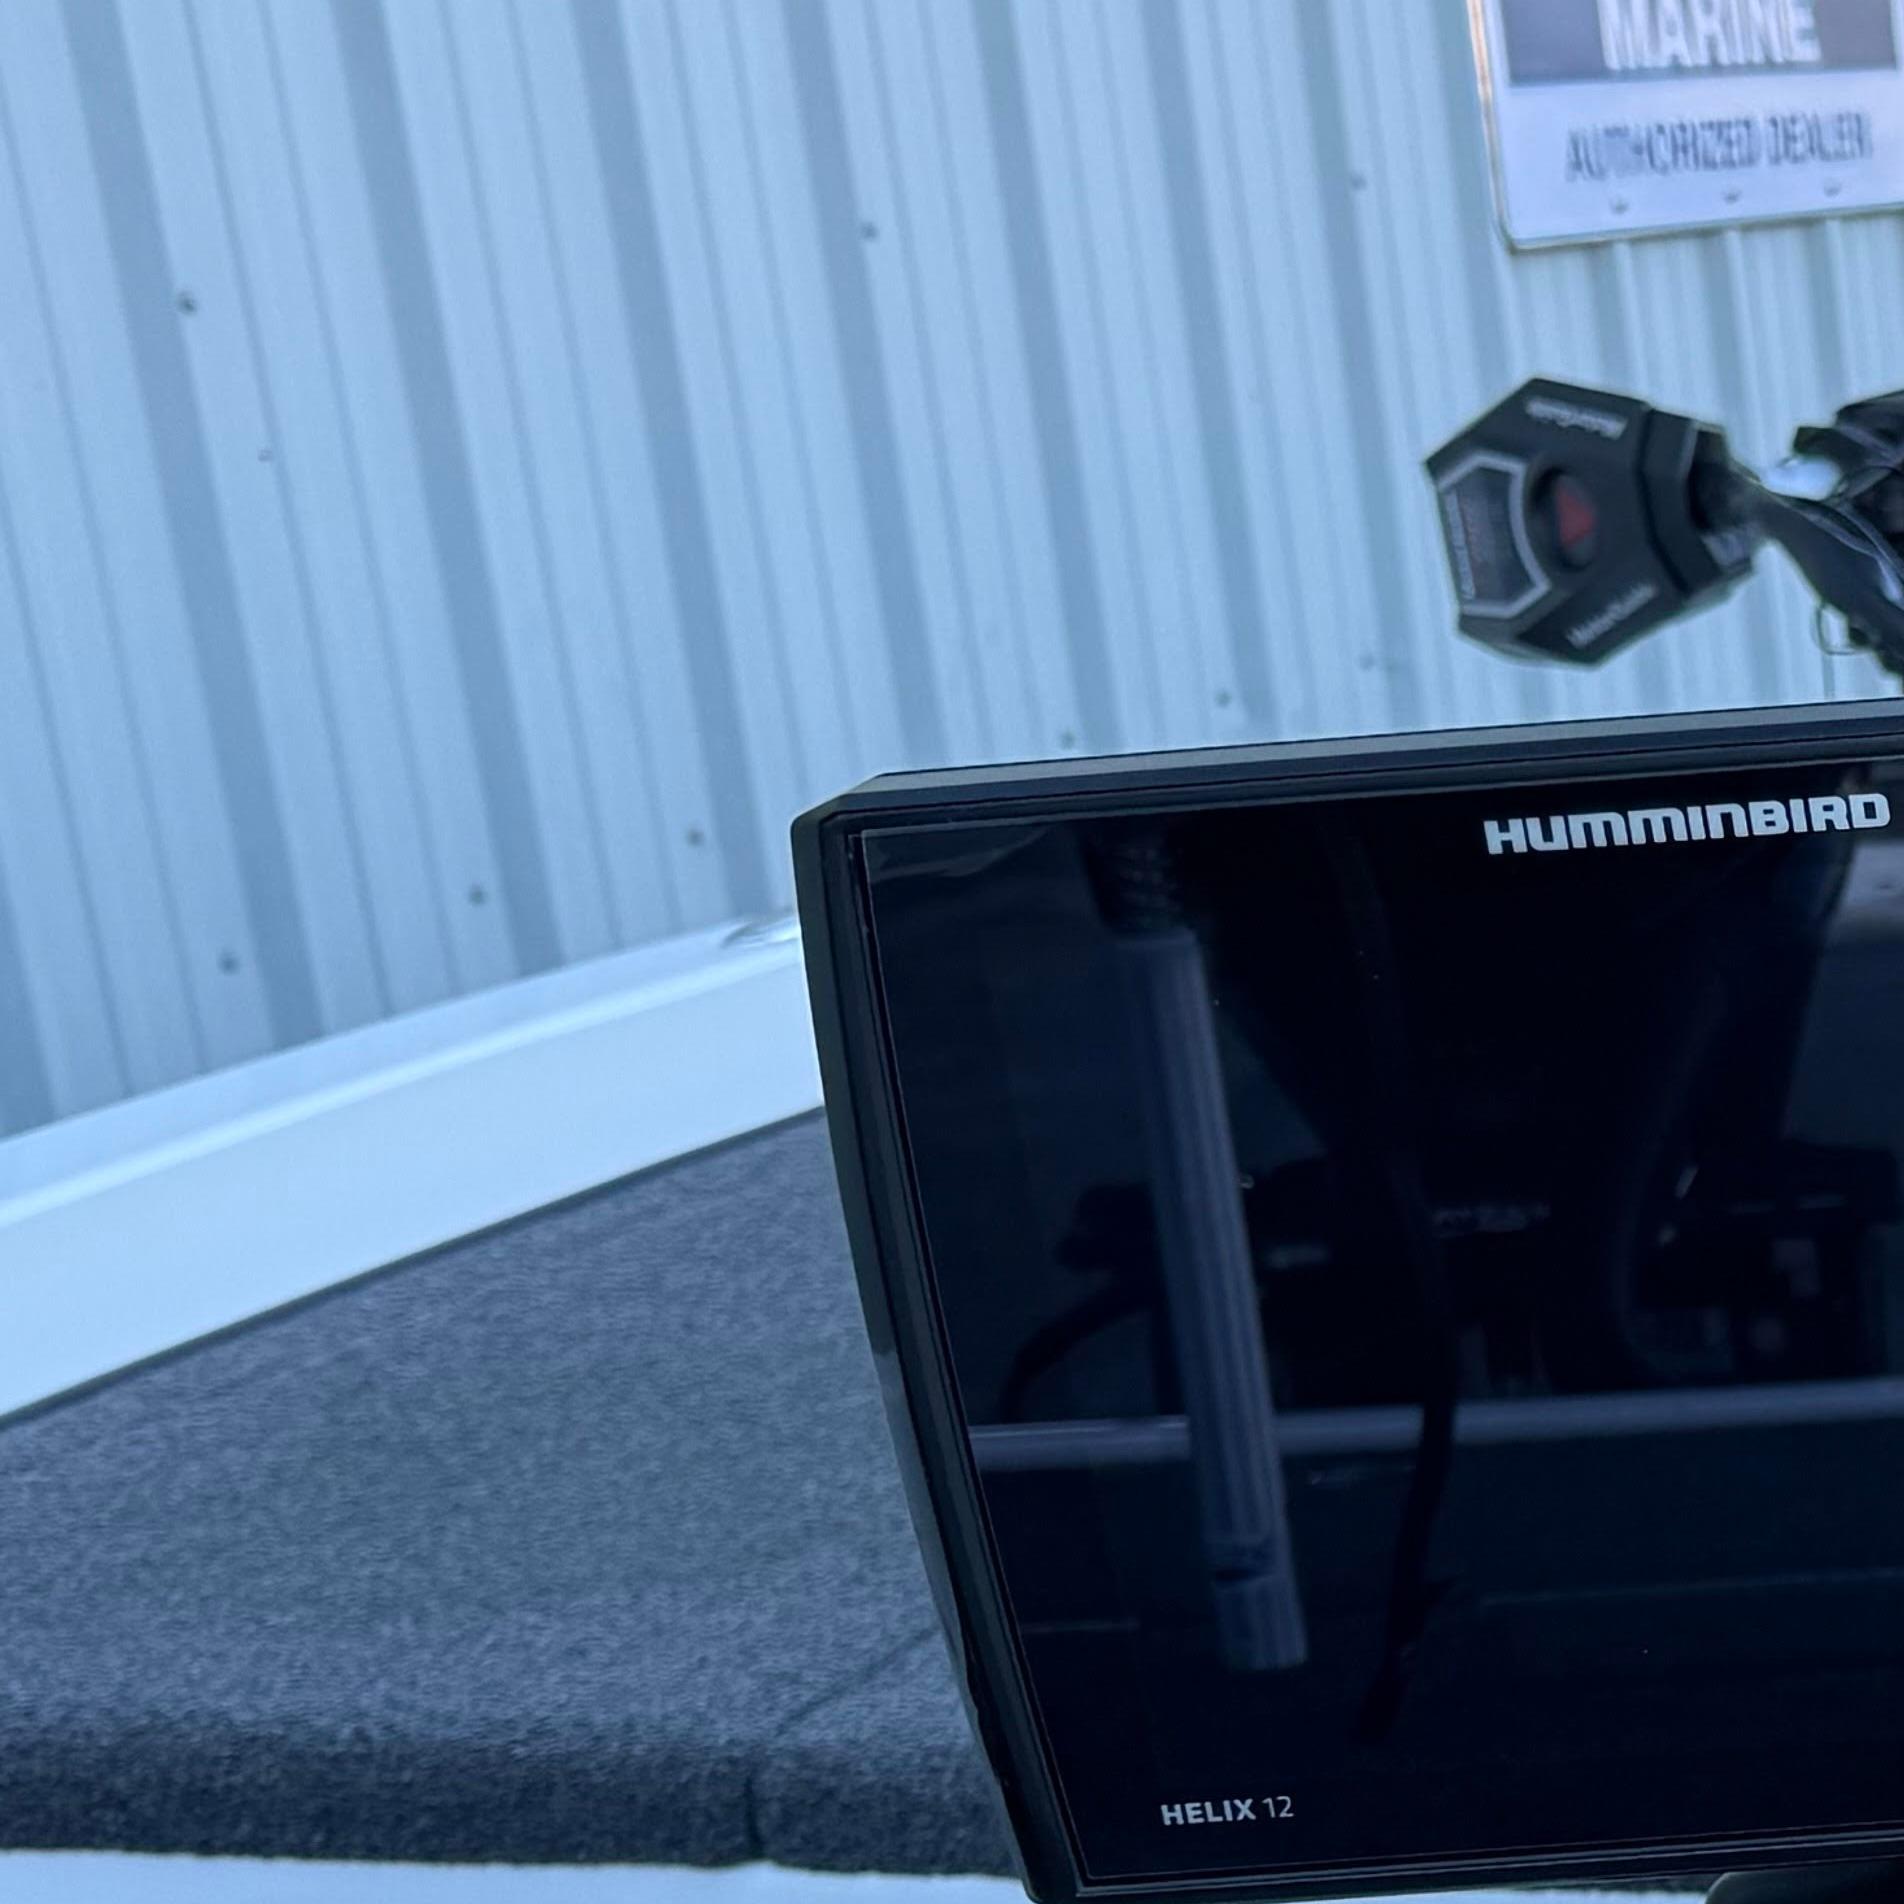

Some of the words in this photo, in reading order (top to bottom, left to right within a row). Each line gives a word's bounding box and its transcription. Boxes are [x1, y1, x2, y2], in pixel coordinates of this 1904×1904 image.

[1566, 115, 1757, 181] AUTHORIZED
[1764, 109, 1873, 167] DEALER
[1483, 792, 1892, 854] HUMMINBIRD
[1160, 1798, 1256, 1826] HELIX
[1262, 1795, 1295, 1819] 12
